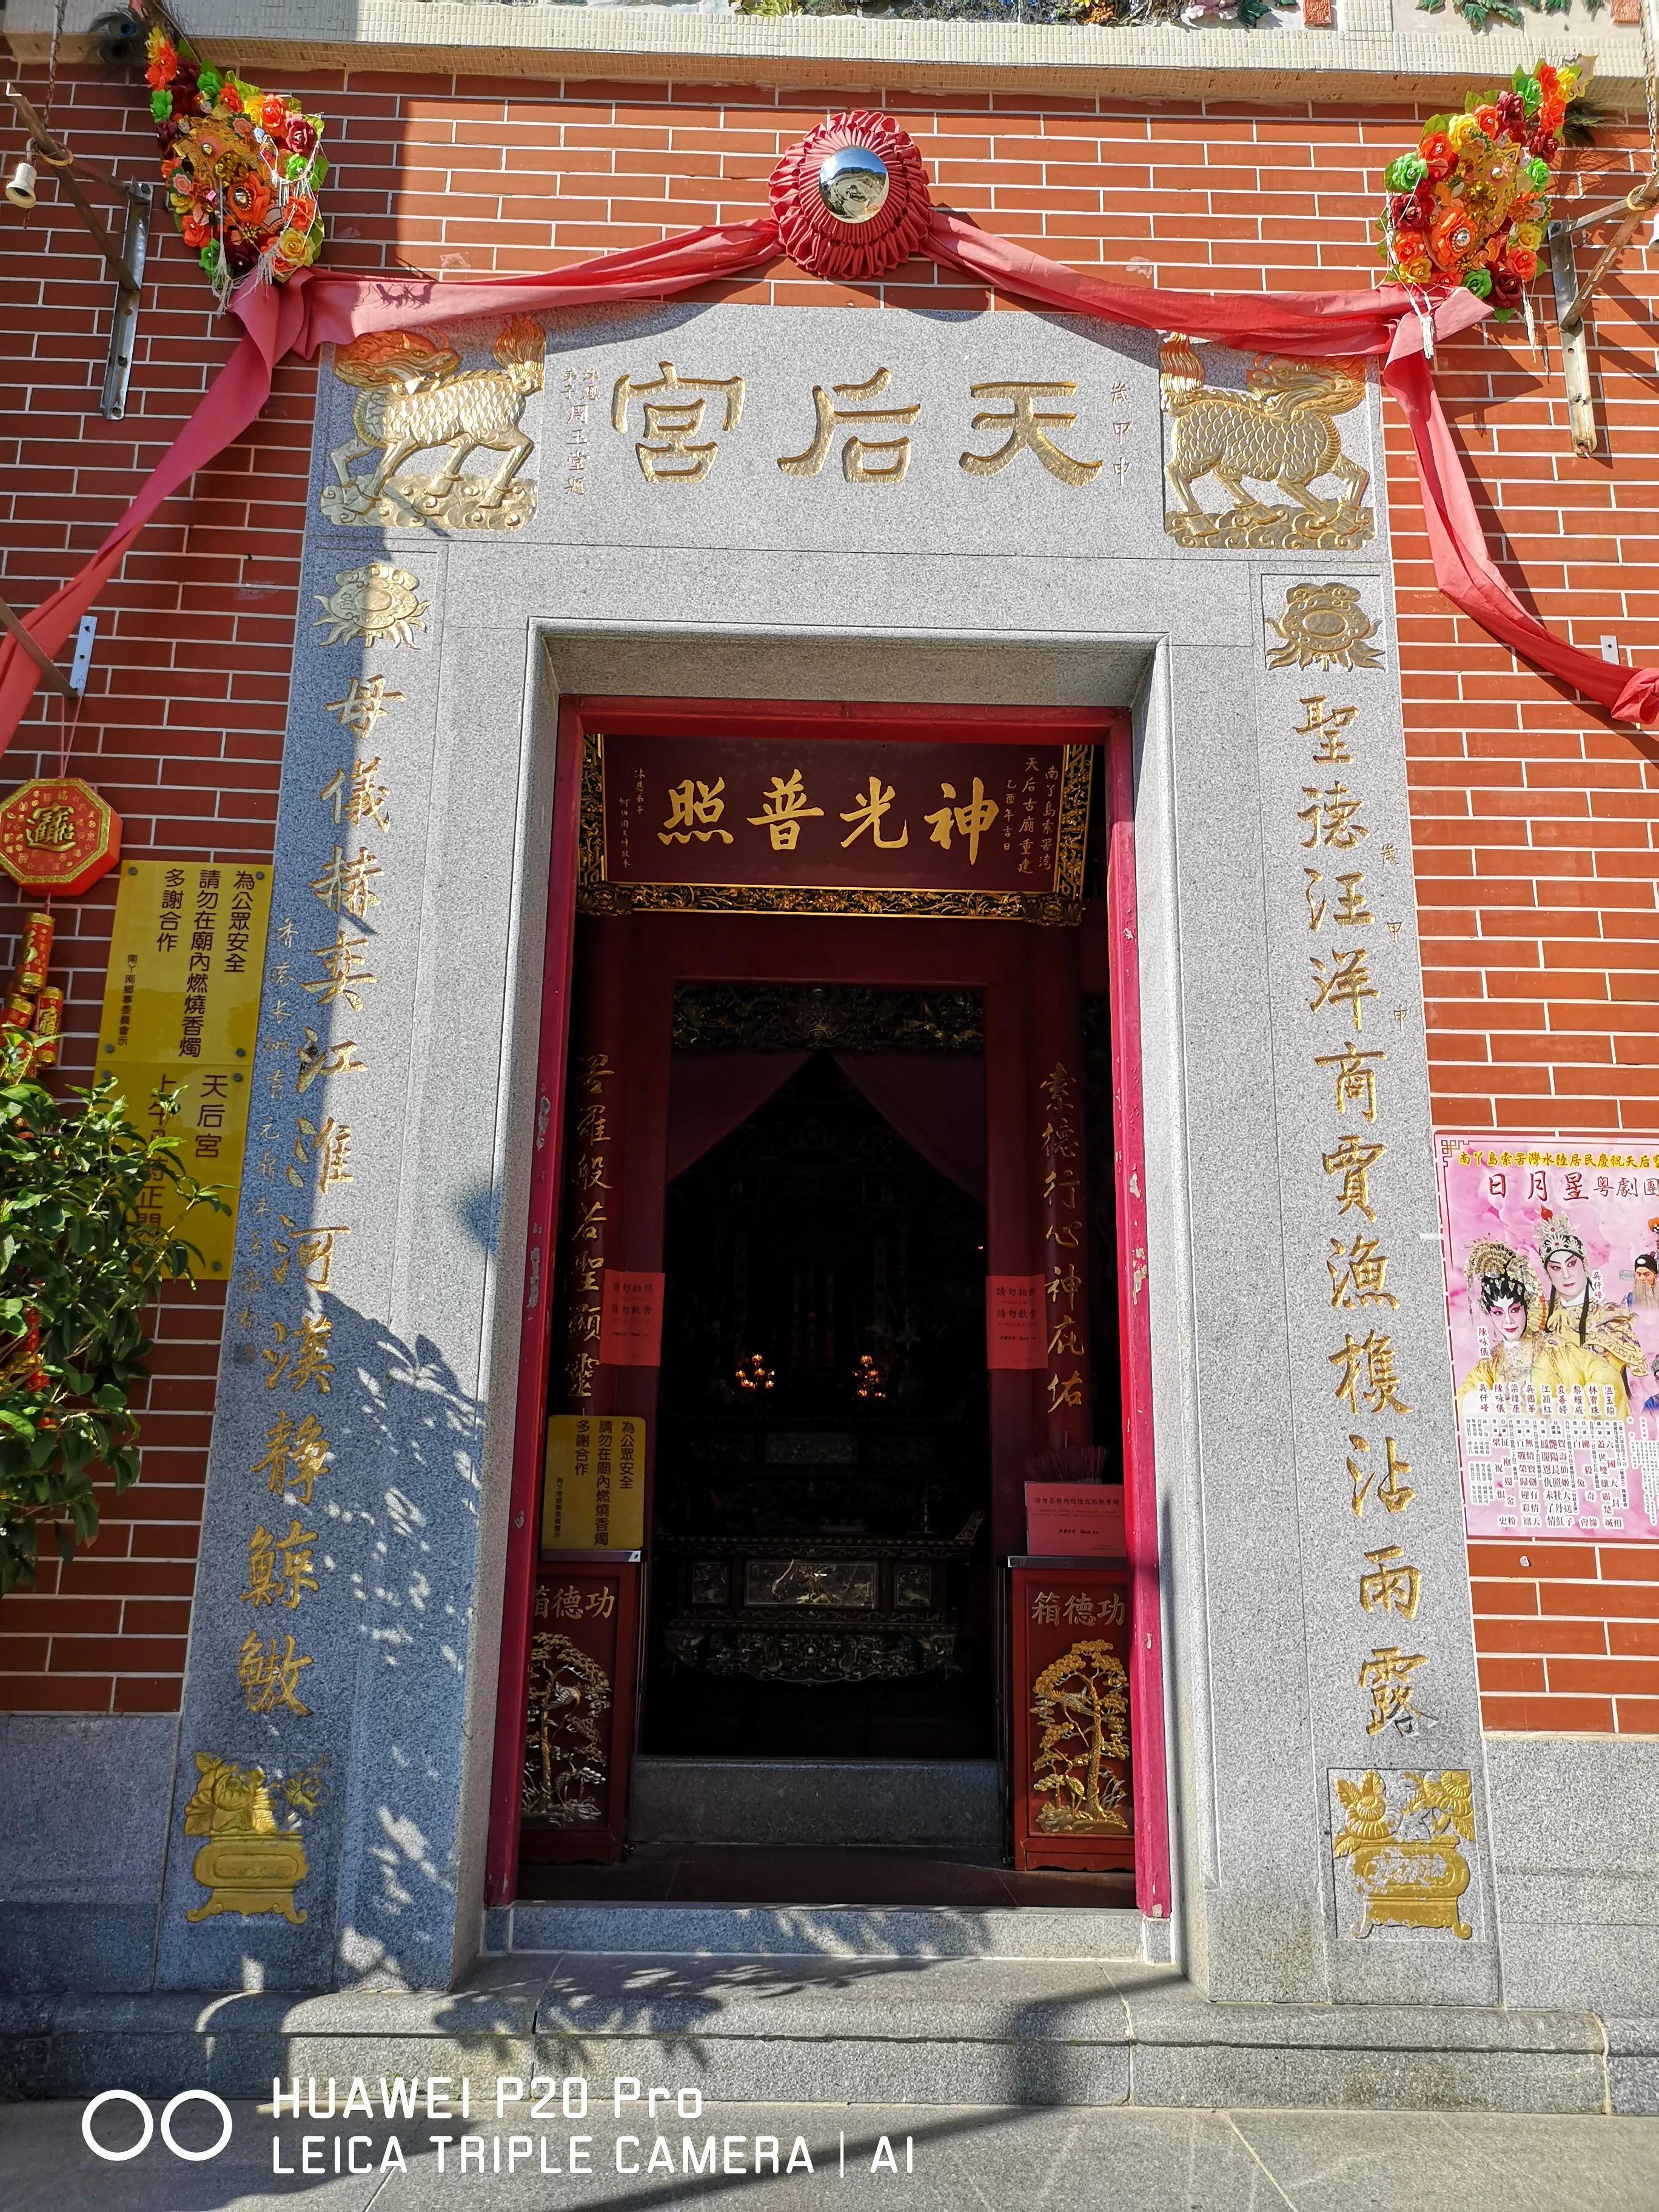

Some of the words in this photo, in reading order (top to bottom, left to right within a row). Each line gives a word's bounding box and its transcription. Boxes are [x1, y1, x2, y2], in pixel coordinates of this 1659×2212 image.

[612, 361, 1103, 484] 天后宮
[658, 769, 1000, 865] 神光普照
[1003, 780, 1016, 850] 乙酉年吉日
[156, 868, 184, 952] 多謝合作
[225, 870, 255, 973] 為公眾安全
[179, 870, 221, 1057] 請勿在廟內燃燒香燭
[195, 1075, 227, 1158] 天后宮
[575, 1420, 590, 1475] 多謝合作
[594, 1420, 612, 1546] 請勿在廟內燃燒香燭
[620, 1421, 635, 1489] 為公眾安全
[1032, 1592, 1126, 1626] 功德箱
